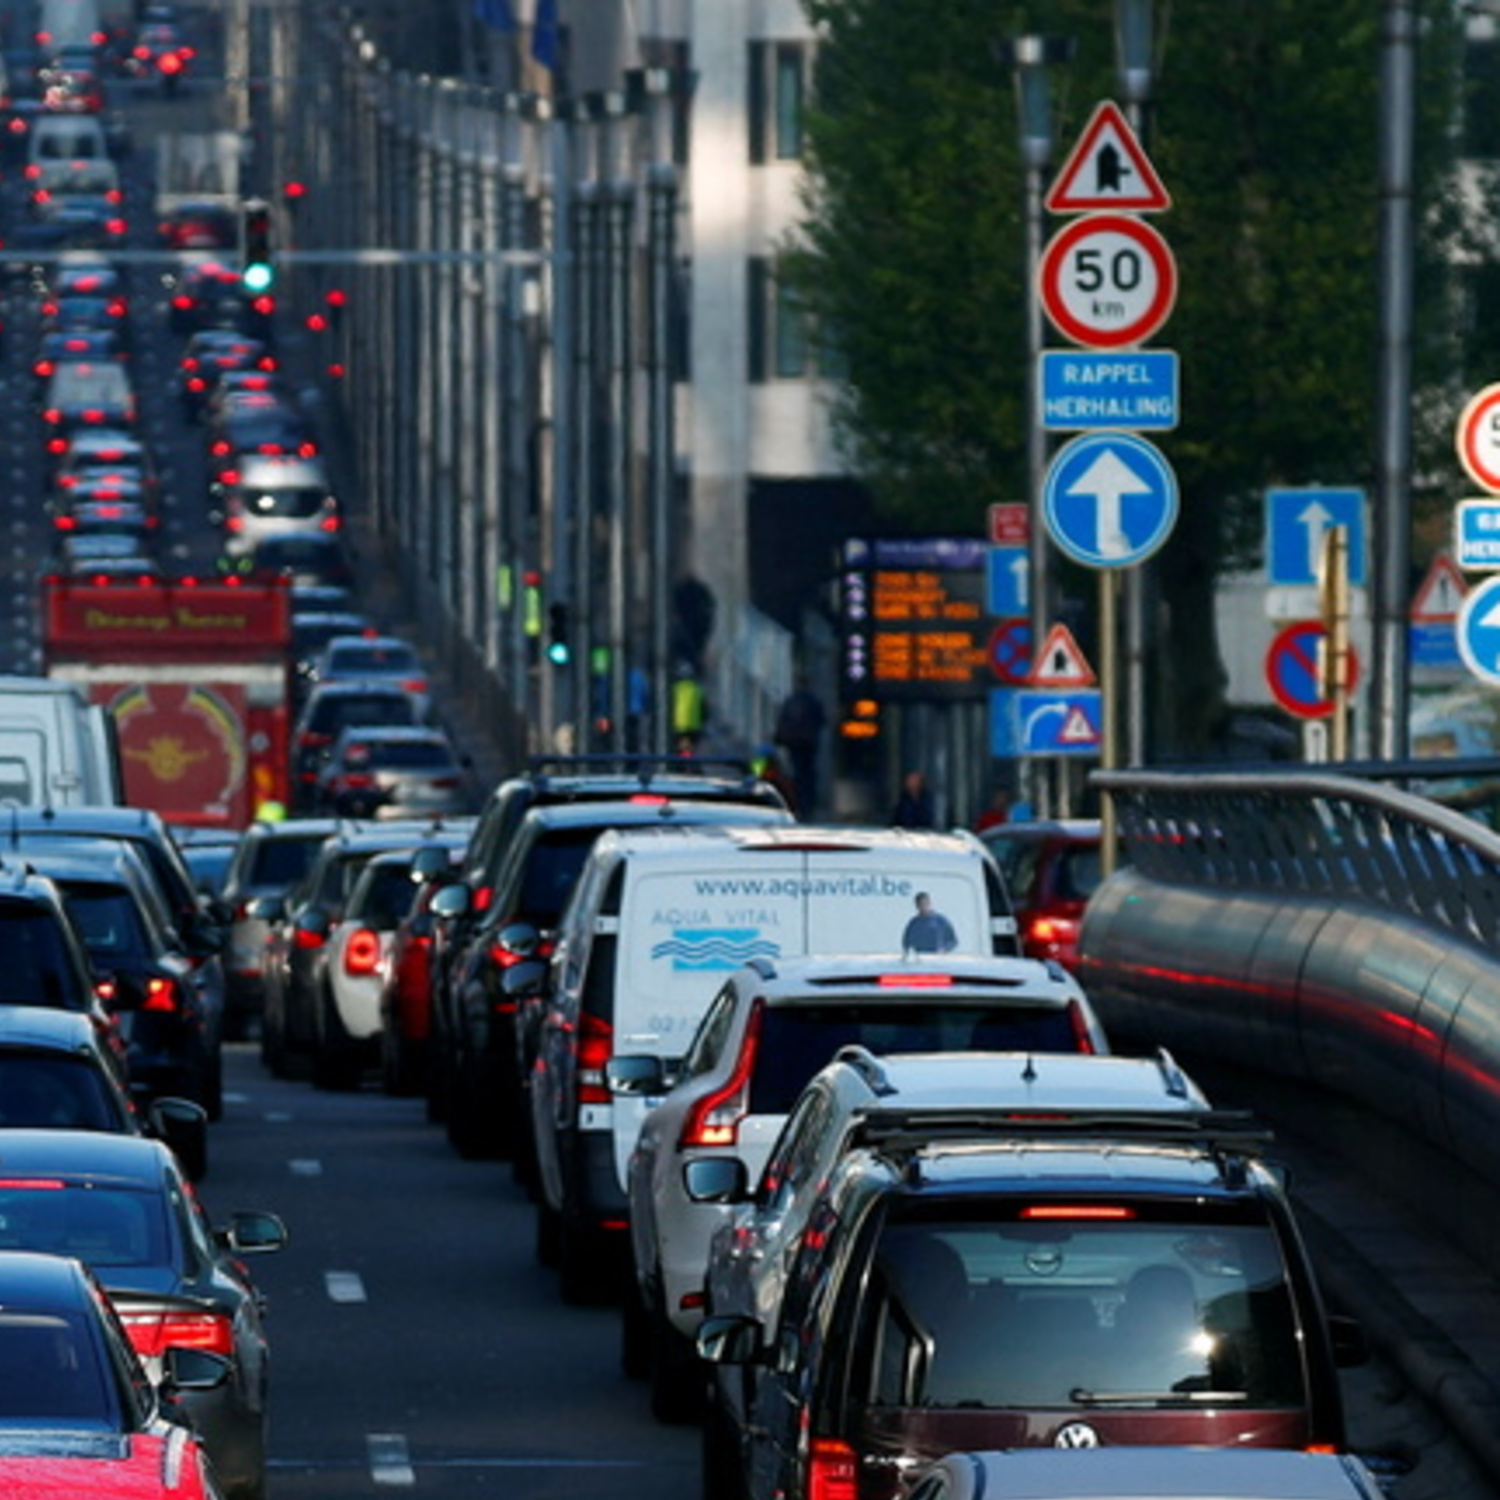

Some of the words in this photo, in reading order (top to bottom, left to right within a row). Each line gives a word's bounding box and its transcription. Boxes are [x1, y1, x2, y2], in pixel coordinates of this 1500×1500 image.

[1074, 249, 1142, 292] 50
[1092, 299, 1125, 318] km
[1062, 364, 1152, 384] RAPPEL
[1046, 397, 1172, 418] HERHALING
[694, 876, 912, 897] www.aquavital.be
[651, 910, 711, 926] AQUA
[724, 910, 781, 926] VITAL
